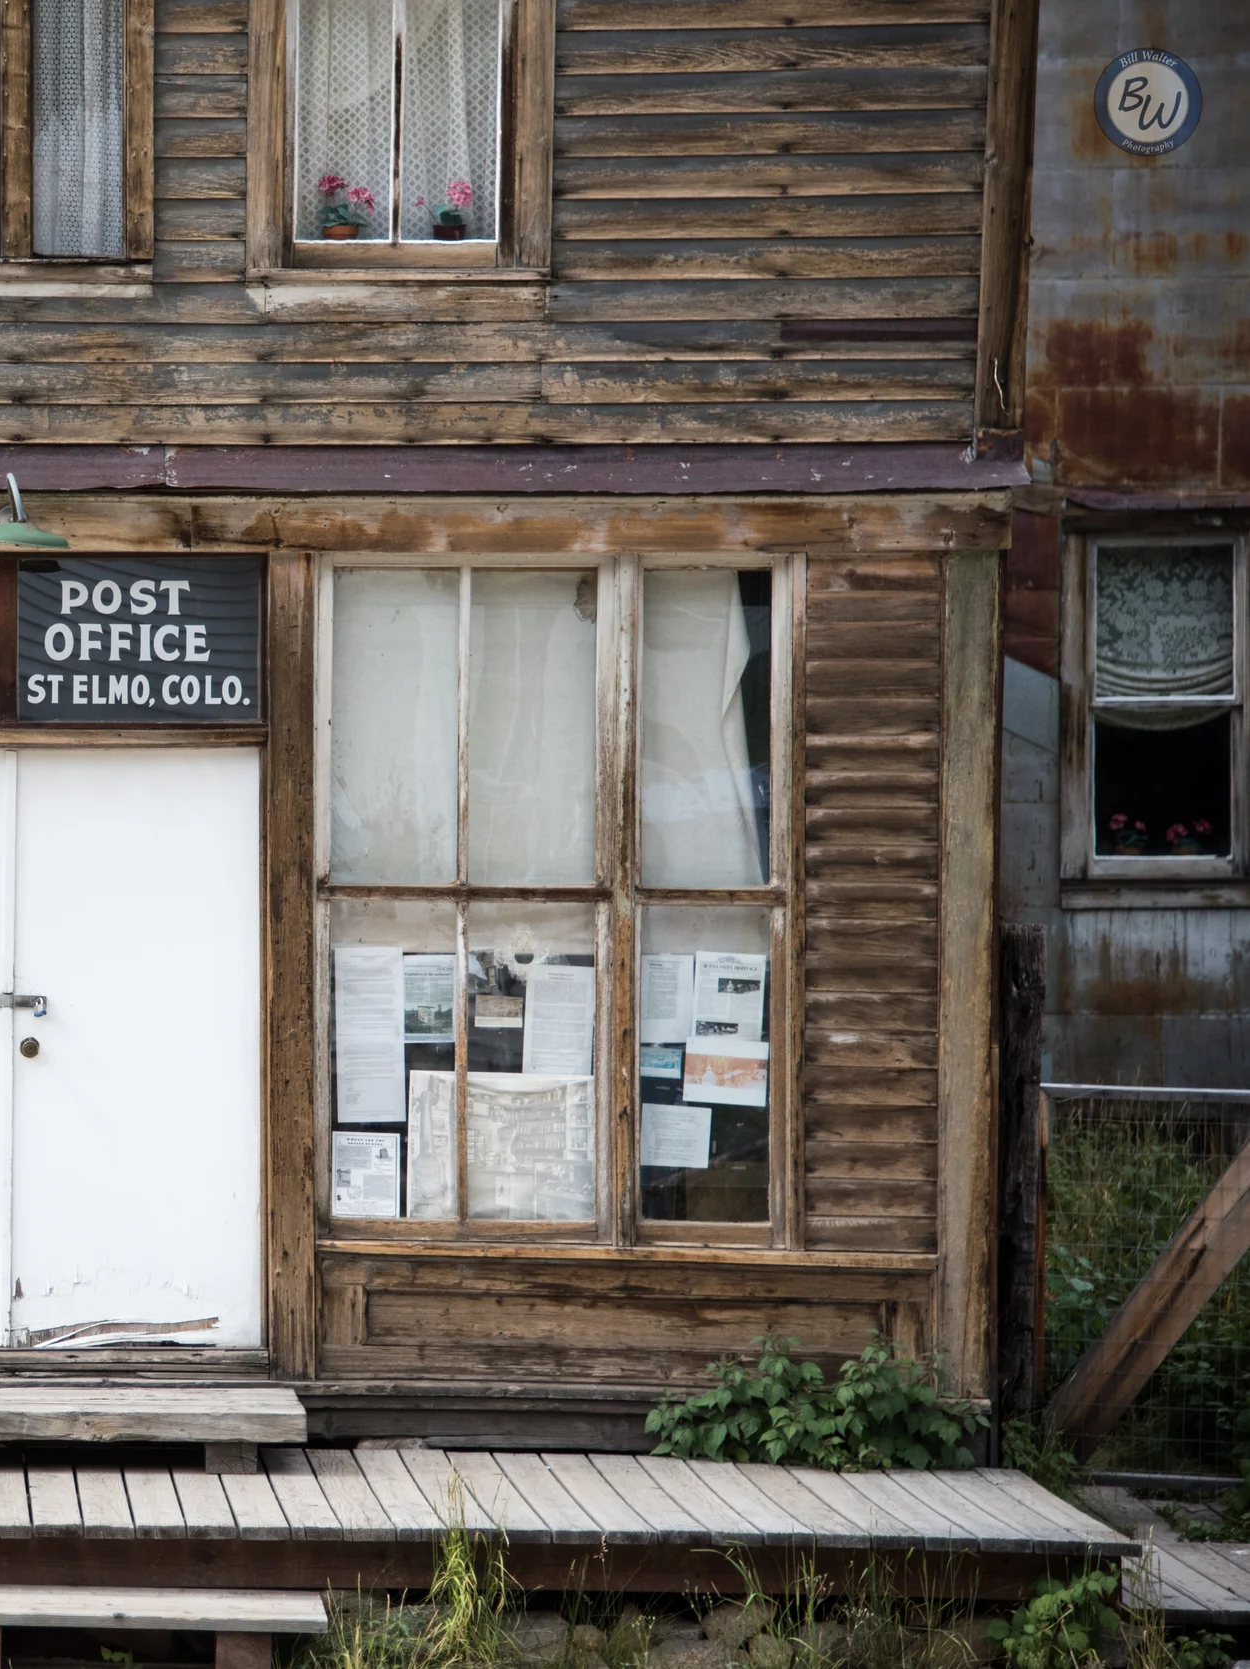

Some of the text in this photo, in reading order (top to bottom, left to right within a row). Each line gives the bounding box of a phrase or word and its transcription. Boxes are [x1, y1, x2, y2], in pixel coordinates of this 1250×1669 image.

[59, 579, 191, 616] POST
[43, 622, 211, 662] OFFICE
[26, 673, 251, 708] ST ELMO, COLO.
